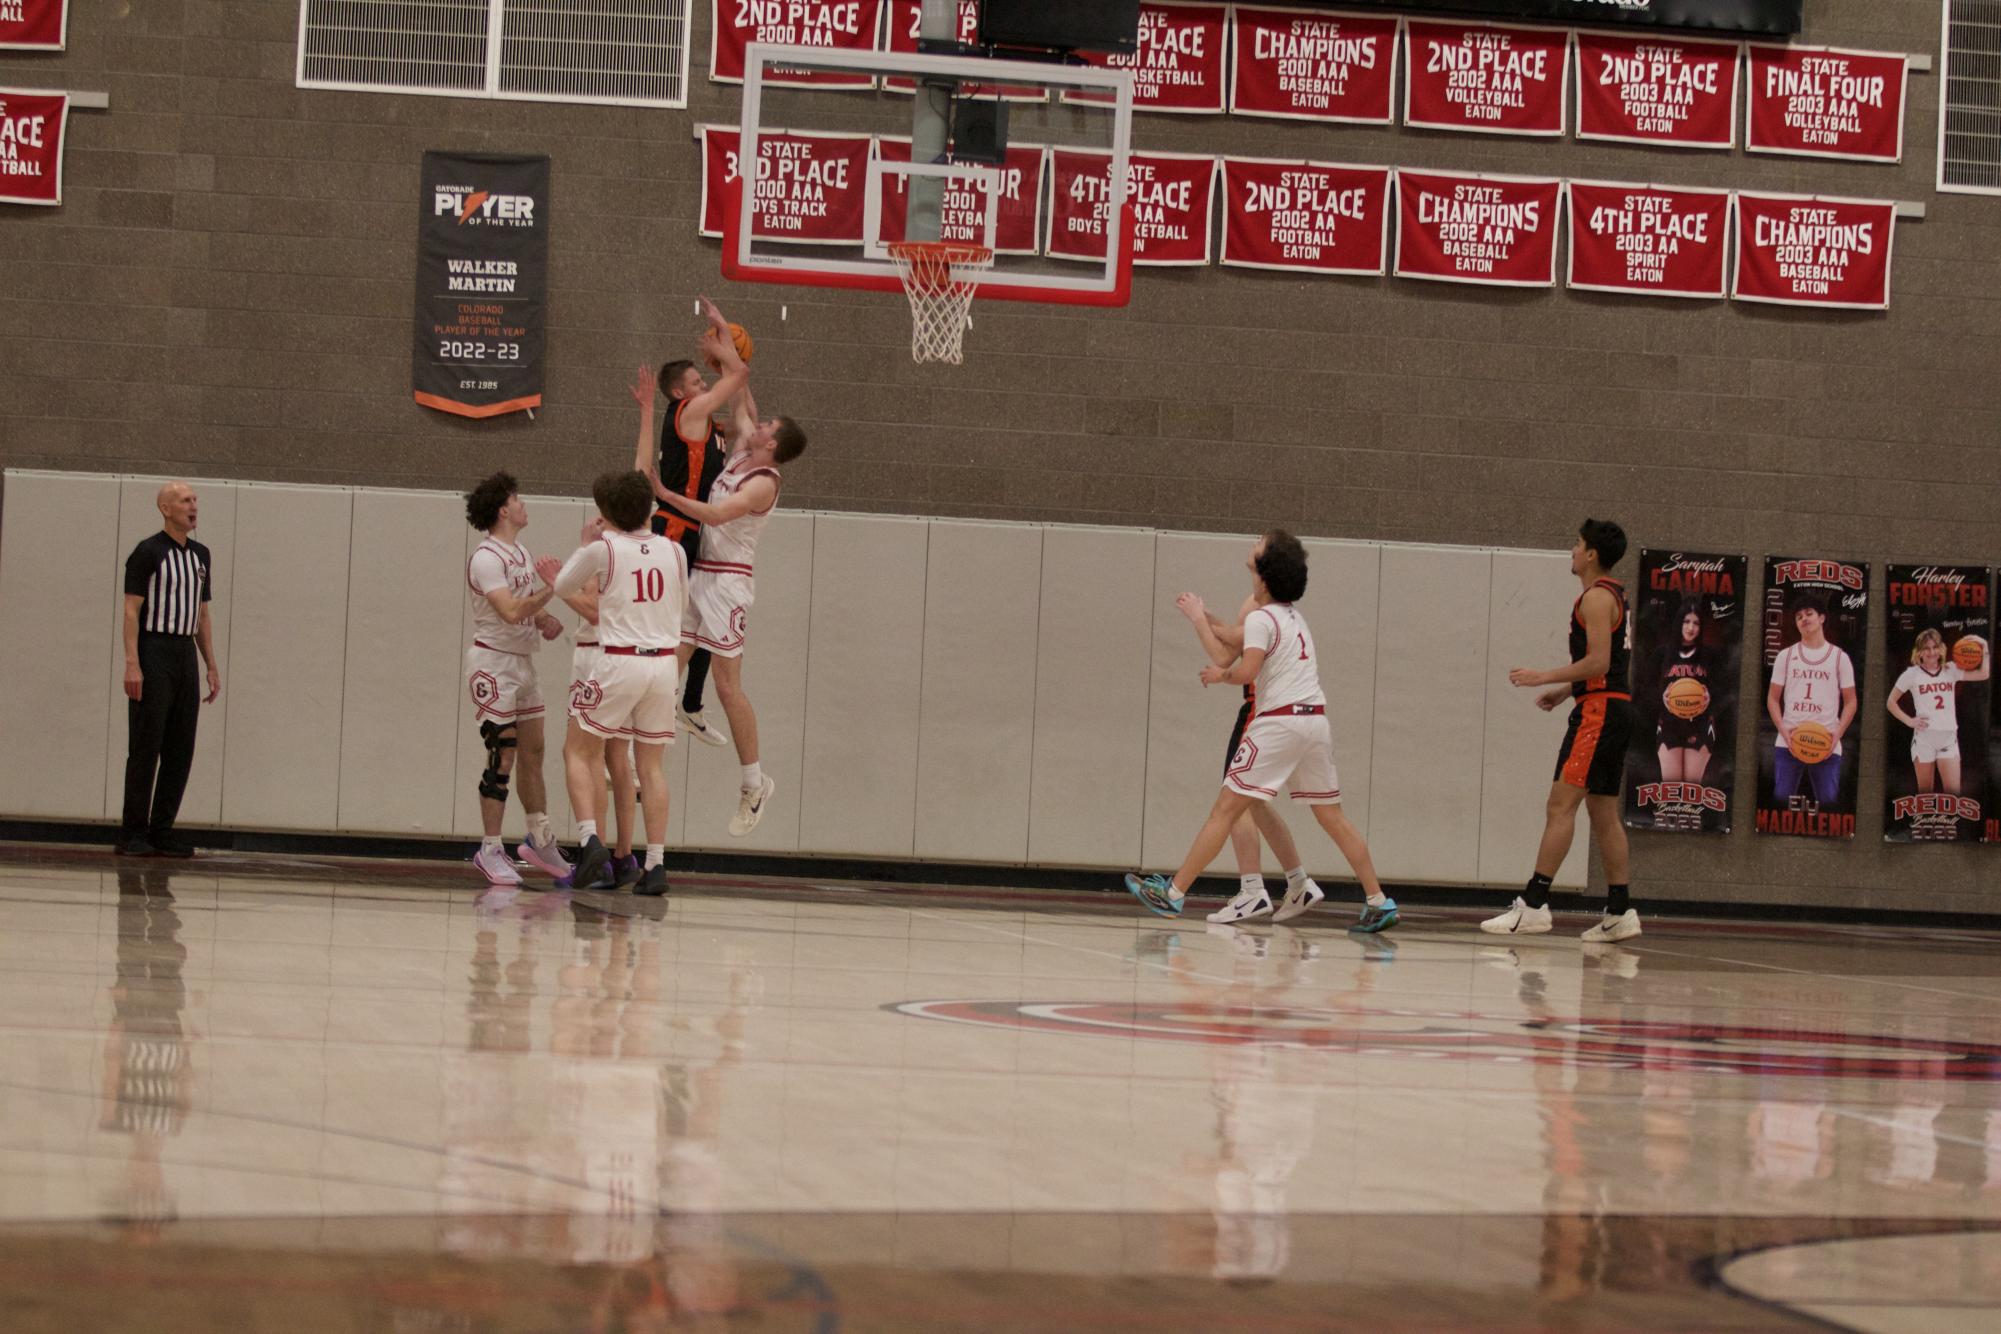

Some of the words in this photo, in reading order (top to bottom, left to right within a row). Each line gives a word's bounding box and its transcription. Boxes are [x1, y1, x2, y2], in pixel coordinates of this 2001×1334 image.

[734, 0, 781, 28] 2ND
[788, 3, 859, 35] PLACE
[1138, 11, 1168, 28] ATE
[757, 25, 796, 43] 2000
[801, 28, 833, 46] AAA
[1291, 20, 1340, 39] STATE
[1137, 26, 1205, 58] PLACE
[1255, 27, 1377, 70] CHAMPIONS
[1463, 32, 1511, 50] STATE
[1146, 50, 1178, 69] AAA
[1427, 42, 1472, 73] 2ND
[1479, 49, 1547, 81] PLACE
[1635, 46, 1683, 64] STATE
[1278, 60, 1312, 77] 2001
[1318, 61, 1348, 80] AAA
[1600, 54, 1644, 86] 2ND
[1650, 63, 1718, 95] PLACE
[1802, 57, 1849, 76] STATE
[1122, 68, 1204, 86] ASKETBALL
[1279, 77, 1345, 96] BASEBALL
[1449, 70, 1486, 89] 2002
[1491, 72, 1522, 92] AAA
[1621, 84, 1658, 102] 2003
[1663, 86, 1694, 105] AAA
[1766, 66, 1824, 97] FINAL
[1830, 75, 1884, 108] FOUR
[1292, 93, 1329, 109] EATON
[1446, 88, 1525, 108] VOLLEYBALL
[1789, 97, 1825, 115] 2003
[1829, 98, 1858, 117] AAA
[1465, 105, 1501, 121] EATON
[1625, 102, 1689, 120] FOOTBALL
[1636, 118, 1673, 133] EATON
[1784, 112, 1861, 133] VOLLEYBALL
[1802, 129, 1838, 145] EATON
[762, 141, 812, 159] STATE
[725, 151, 771, 183] 3D
[778, 158, 849, 190] PLACE
[1281, 172, 1329, 190] STATE
[792, 182, 824, 201] AAA
[1070, 174, 1112, 203] 4TH
[1126, 181, 1192, 212] PLACE
[1244, 182, 1290, 213] 2ND
[1297, 188, 1365, 220] PLACE
[1455, 185, 1503, 203] STATE
[753, 199, 778, 214] OYS
[783, 200, 827, 217] TRACK
[1418, 192, 1539, 232] CHAMPIONS
[1625, 195, 1672, 213] STATE
[469, 217, 481, 225] OF
[486, 217, 505, 226] THE
[509, 218, 534, 227] YEAR
[764, 215, 802, 230] EATON
[1068, 218, 1101, 234] BOYS
[1272, 210, 1309, 228] 2002
[1315, 212, 1335, 231] AA
[1590, 206, 1633, 236] 4TH
[1640, 212, 1708, 244] PLACE
[1790, 207, 1837, 226] STATE
[941, 226, 974, 240] ATON
[1271, 229, 1336, 247] FOOTBALL
[1440, 223, 1477, 241] 2002
[1484, 225, 1514, 245] AAA
[1755, 214, 1872, 255] CHAMPIONS
[1283, 245, 1320, 260] EATON
[1443, 242, 1509, 260] BASEBALL
[1616, 234, 1653, 252] 2003
[1658, 236, 1678, 255] AA
[1456, 257, 1492, 273] EATON
[1627, 253, 1667, 269] SPIRIT
[1776, 245, 1813, 263] 2003
[1818, 247, 1849, 267] AAA
[448, 259, 517, 275] WALKER
[1627, 266, 1663, 283] EATON
[1780, 263, 1844, 281] BASEBALL
[449, 276, 515, 292] MARTIN
[1792, 278, 1829, 295] EATON
[458, 303, 503, 314] COLORADO
[458, 315, 501, 325] BASEBALL
[434, 325, 467, 336] PLAYER
[470, 326, 481, 335] OF
[484, 326, 500, 336] THE
[503, 327, 526, 337] YEAR
[440, 341, 519, 360] 2022-23
[1774, 560, 1863, 590] REDS
[1912, 567, 1966, 592] Harley
[632, 568, 664, 603] 10
[1889, 582, 1986, 608] FORSTER
[1297, 632, 1309, 660] 1
[1792, 669, 1831, 681] EATON
[1804, 683, 1812, 700] 1
[1919, 682, 1953, 695] EATON
[1792, 703, 1823, 713] REDS
[1934, 696, 1945, 710] 2
[1800, 735, 1826, 747] Wilson
[1636, 782, 1726, 811] REDS
[1893, 793, 1980, 821] REDS
[1756, 809, 1856, 837] MADALENO
